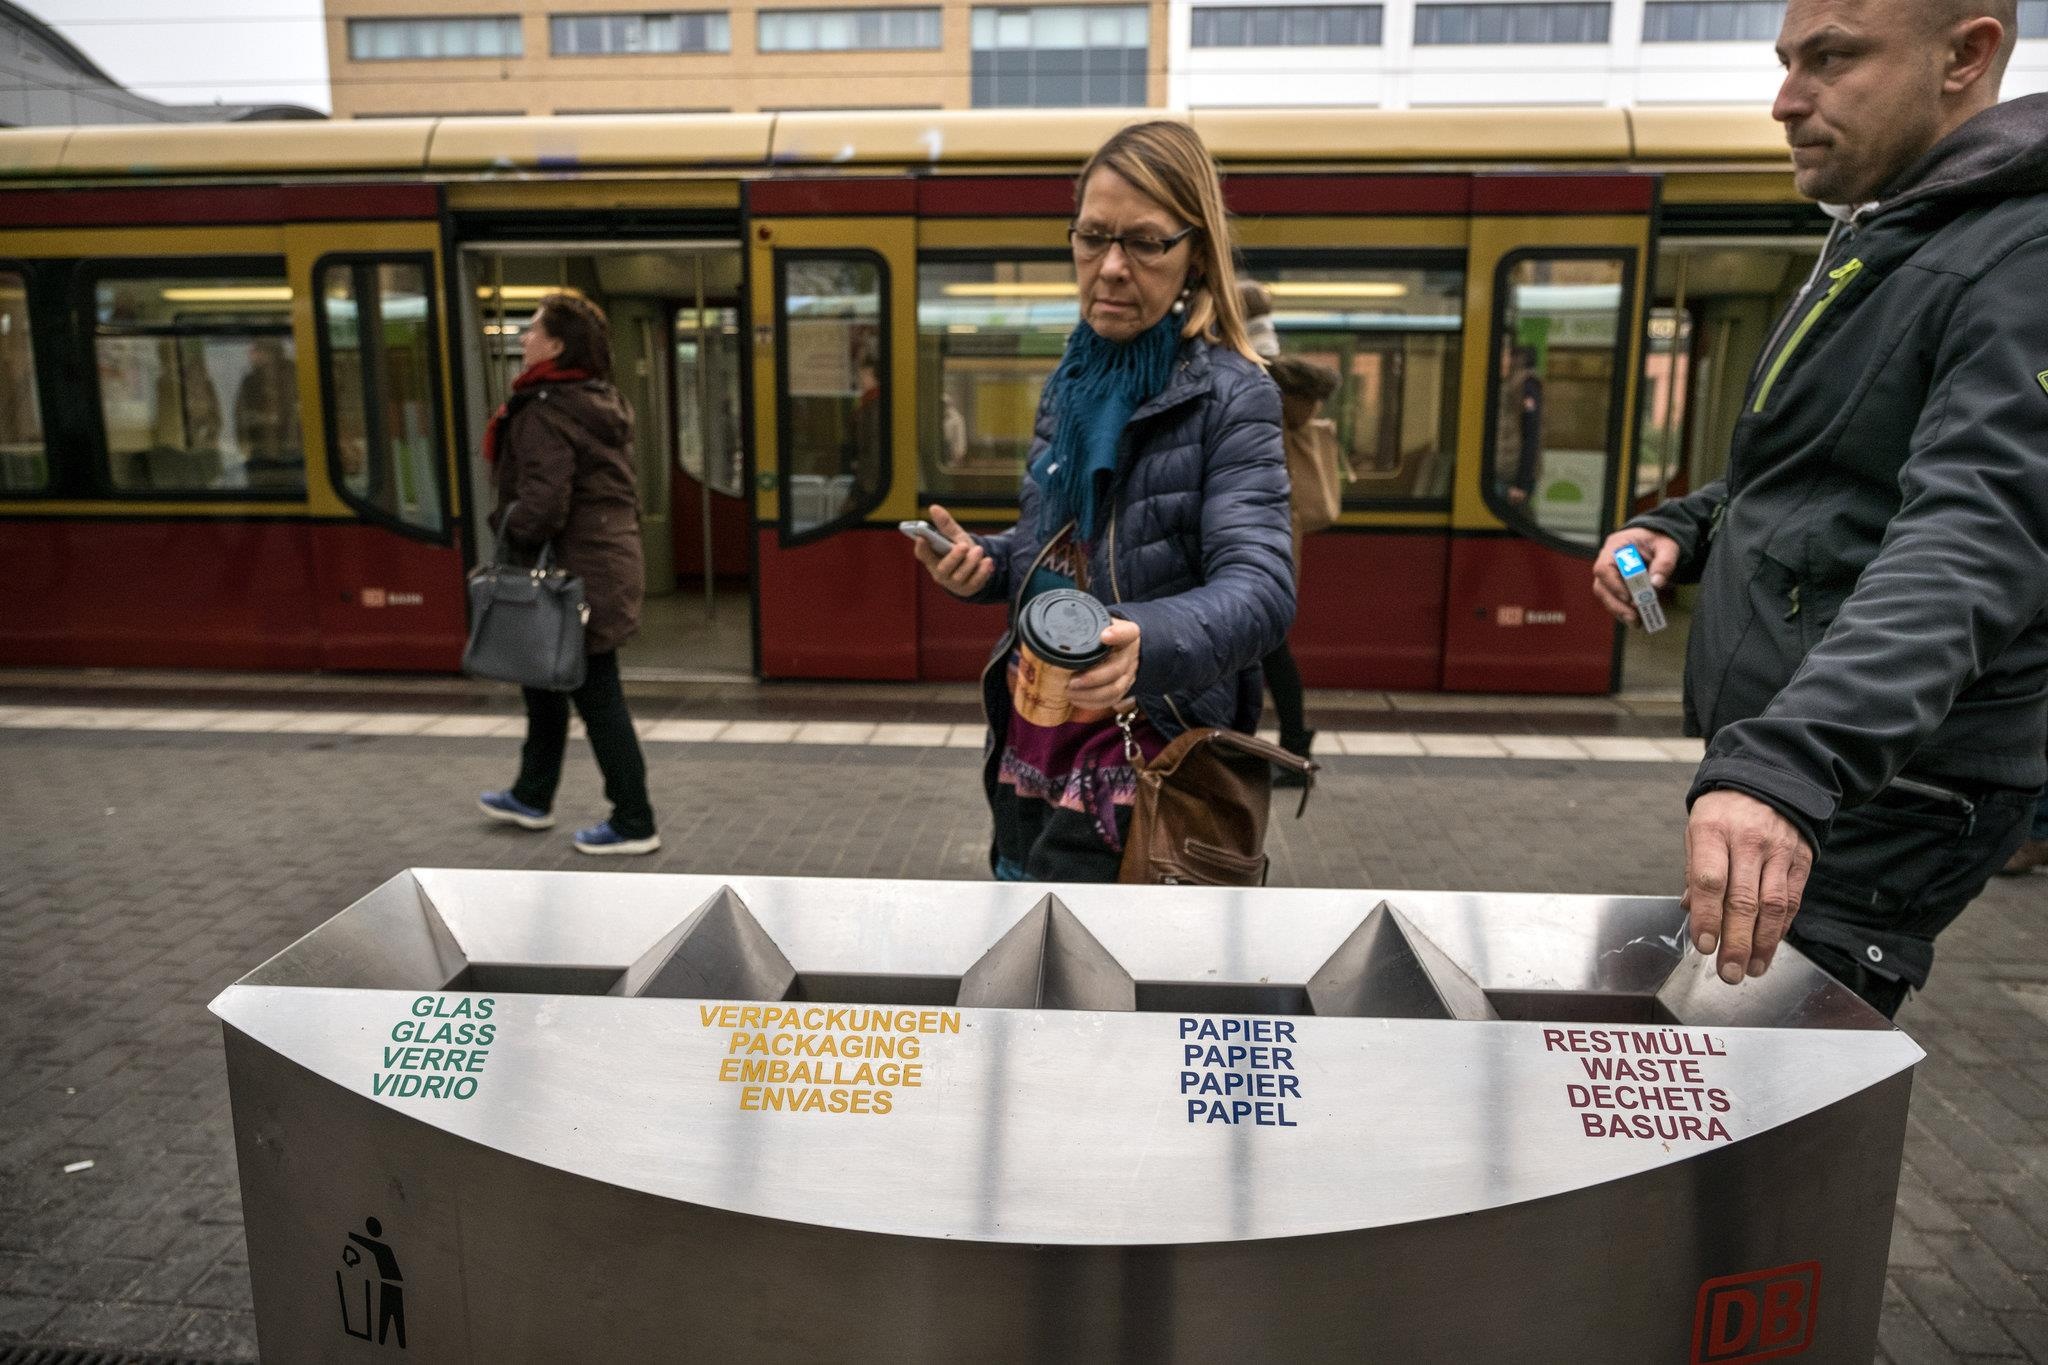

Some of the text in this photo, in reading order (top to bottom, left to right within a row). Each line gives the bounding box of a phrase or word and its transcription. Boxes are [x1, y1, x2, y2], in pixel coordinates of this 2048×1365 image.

[412, 996, 495, 1019] GLAS
[699, 1005, 962, 1034] VERPACKUNGEN
[391, 1021, 496, 1046] GLASS
[1180, 1018, 1297, 1043] PAPIER
[1543, 1029, 1727, 1056] RESTMÜLL
[384, 1046, 489, 1072] VERRE
[729, 1031, 921, 1060] PACKAGING
[1185, 1044, 1295, 1070] PAPER
[718, 1057, 923, 1088] EMBALLAGE
[1580, 1057, 1704, 1083] WASTE
[373, 1073, 478, 1100] VIDRIO
[1181, 1071, 1302, 1098] PAPIER
[1567, 1084, 1731, 1112] DECHETS
[739, 1085, 893, 1115] ENVASES
[1188, 1099, 1298, 1127] PAPEL
[1581, 1113, 1733, 1142] BASURA
[1707, 1279, 1806, 1357] DB
